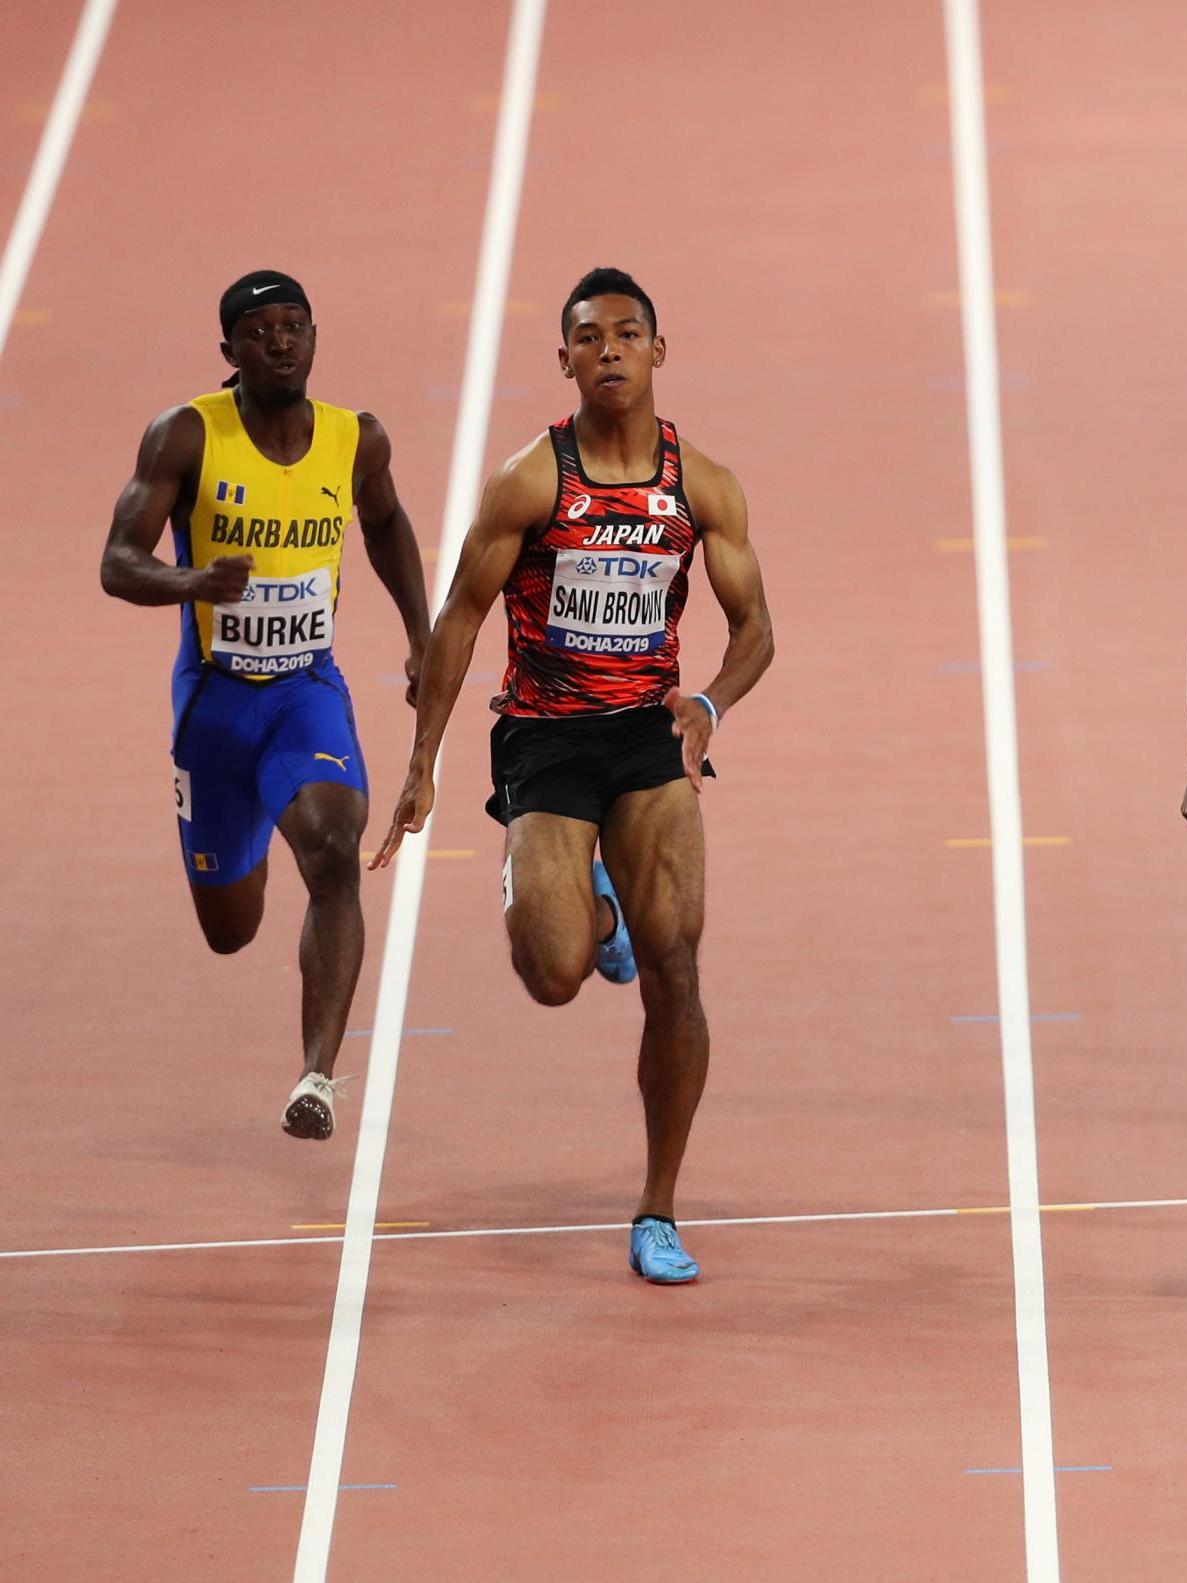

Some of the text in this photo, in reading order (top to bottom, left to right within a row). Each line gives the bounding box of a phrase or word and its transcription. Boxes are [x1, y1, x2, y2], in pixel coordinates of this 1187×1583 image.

[211, 513, 343, 548] BARBADOS
[582, 524, 666, 545] JAPAN
[598, 557, 663, 579] TDK
[256, 577, 318, 602] TDK
[553, 585, 663, 626] SANI BROWN
[220, 608, 326, 647] BURKE
[564, 632, 650, 653] DOHA2019
[230, 652, 315, 673] DOHA2019
